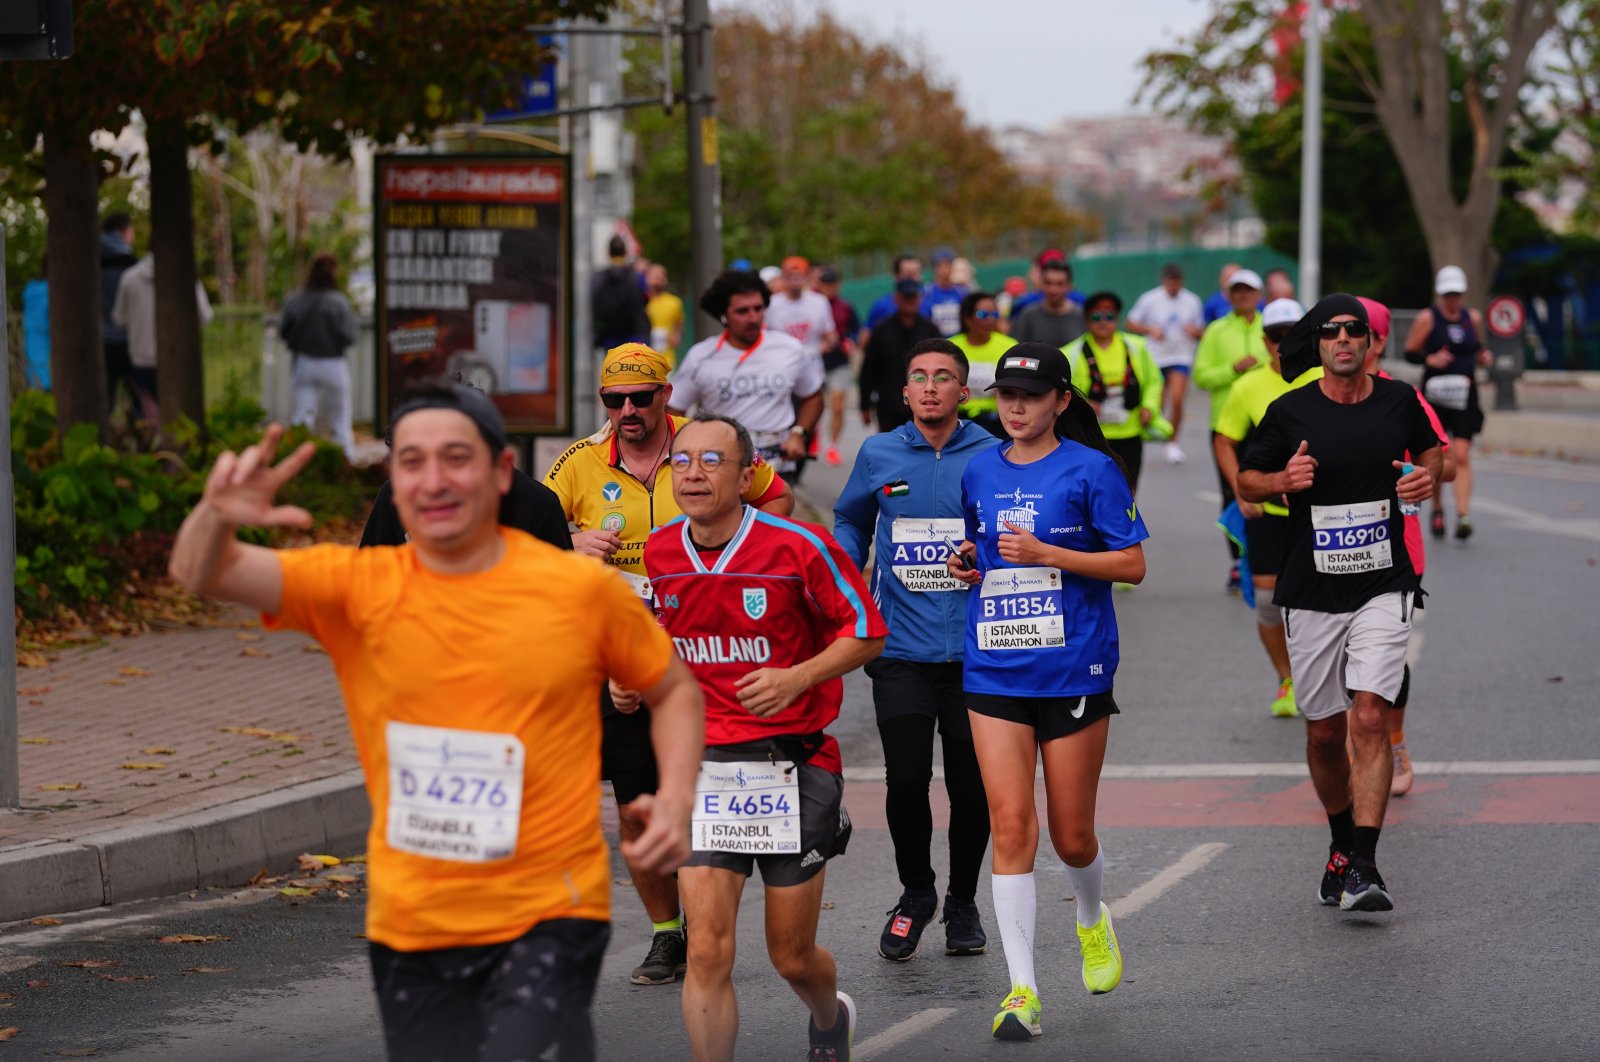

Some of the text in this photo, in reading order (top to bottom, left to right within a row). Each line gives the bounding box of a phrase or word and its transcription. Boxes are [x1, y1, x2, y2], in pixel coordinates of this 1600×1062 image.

[387, 166, 558, 196] hepsiburada
[1315, 525, 1387, 547] D 16910
[894, 544, 909, 561] A
[1327, 551, 1374, 563] ISTANBUL
[1327, 562, 1375, 572] MARATHON
[905, 581, 956, 589] MARATHON
[984, 596, 1057, 617] B 11354
[991, 624, 1040, 636] ISTANBUL
[672, 635, 771, 664] THAILAND
[990, 637, 1042, 648] MARATHON
[401, 768, 509, 808] D 4276
[704, 793, 791, 815] E 4654
[712, 824, 773, 837] ISTANBUL
[710, 839, 774, 851] MARATHON
